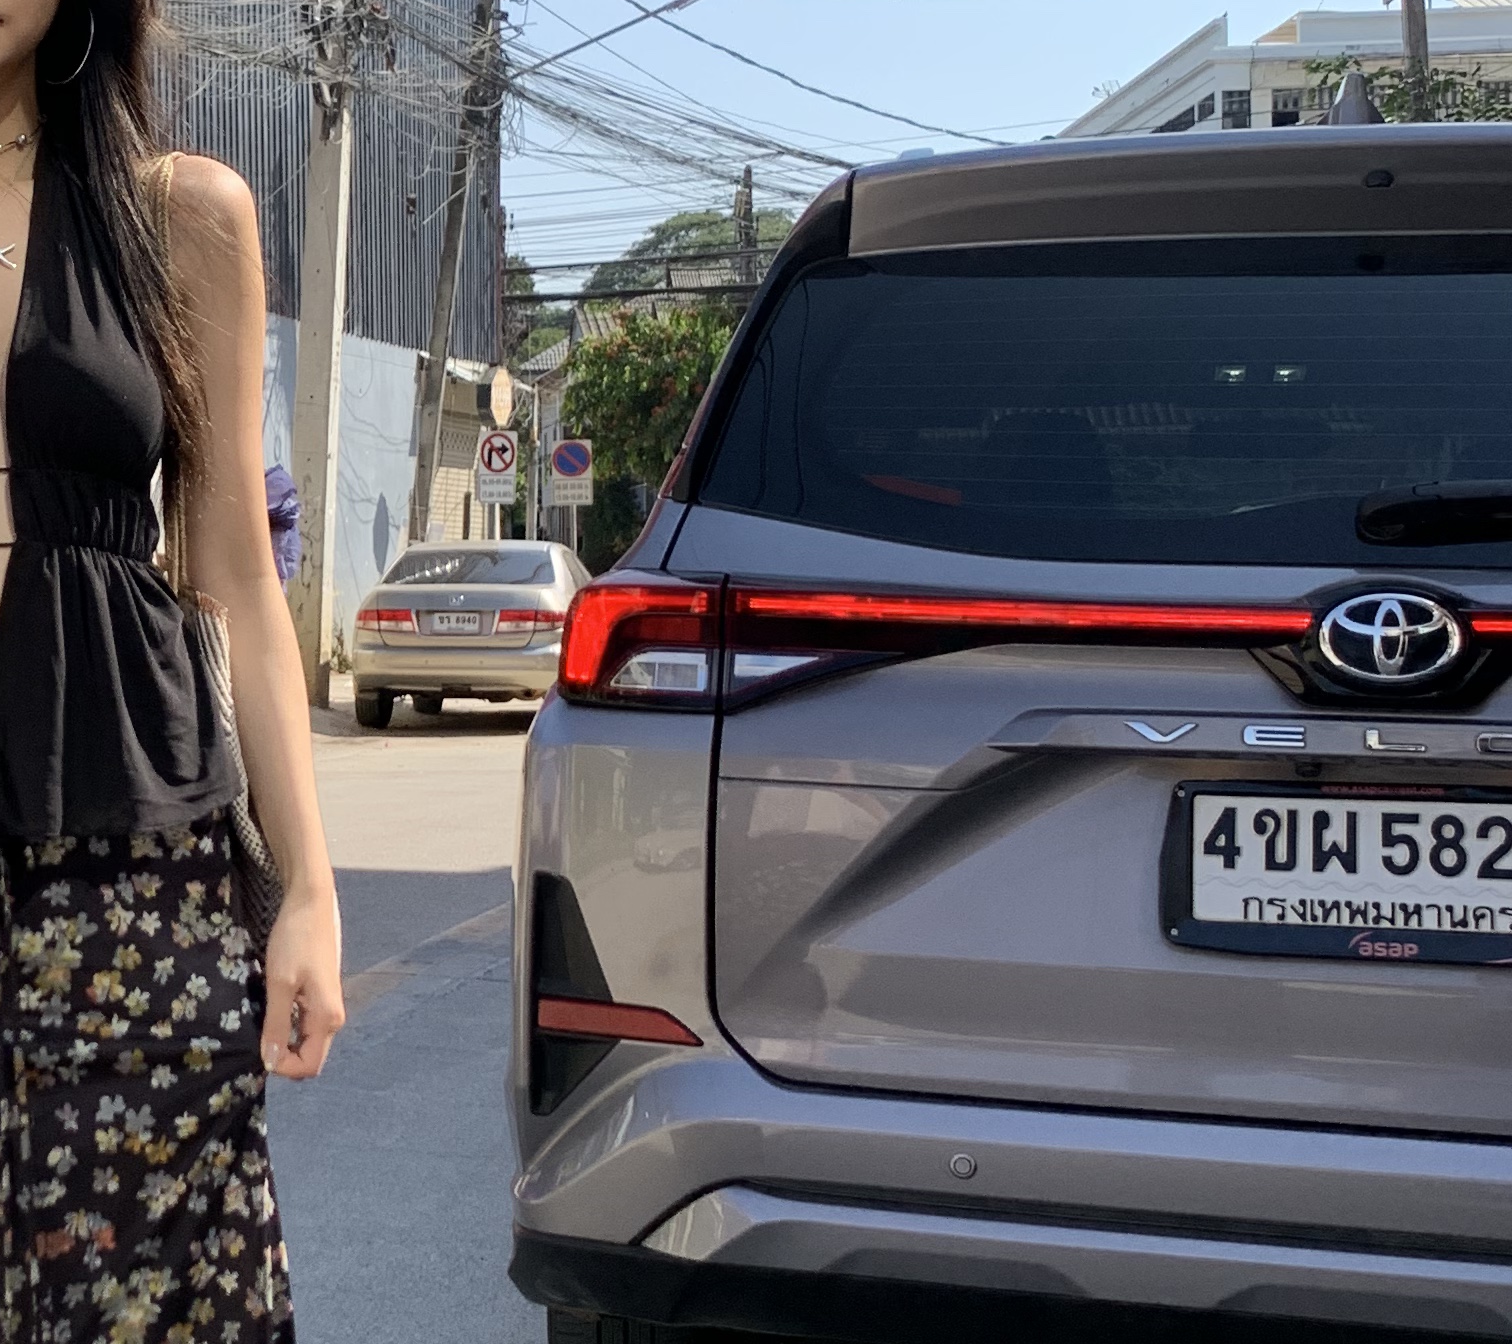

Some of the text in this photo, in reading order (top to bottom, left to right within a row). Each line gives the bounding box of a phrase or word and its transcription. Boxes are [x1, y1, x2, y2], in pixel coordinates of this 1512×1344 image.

[1381, 812, 1512, 881] 582
[1242, 896, 1512, 931] กรงเทพมหานคร
[1358, 941, 1419, 958] asap
